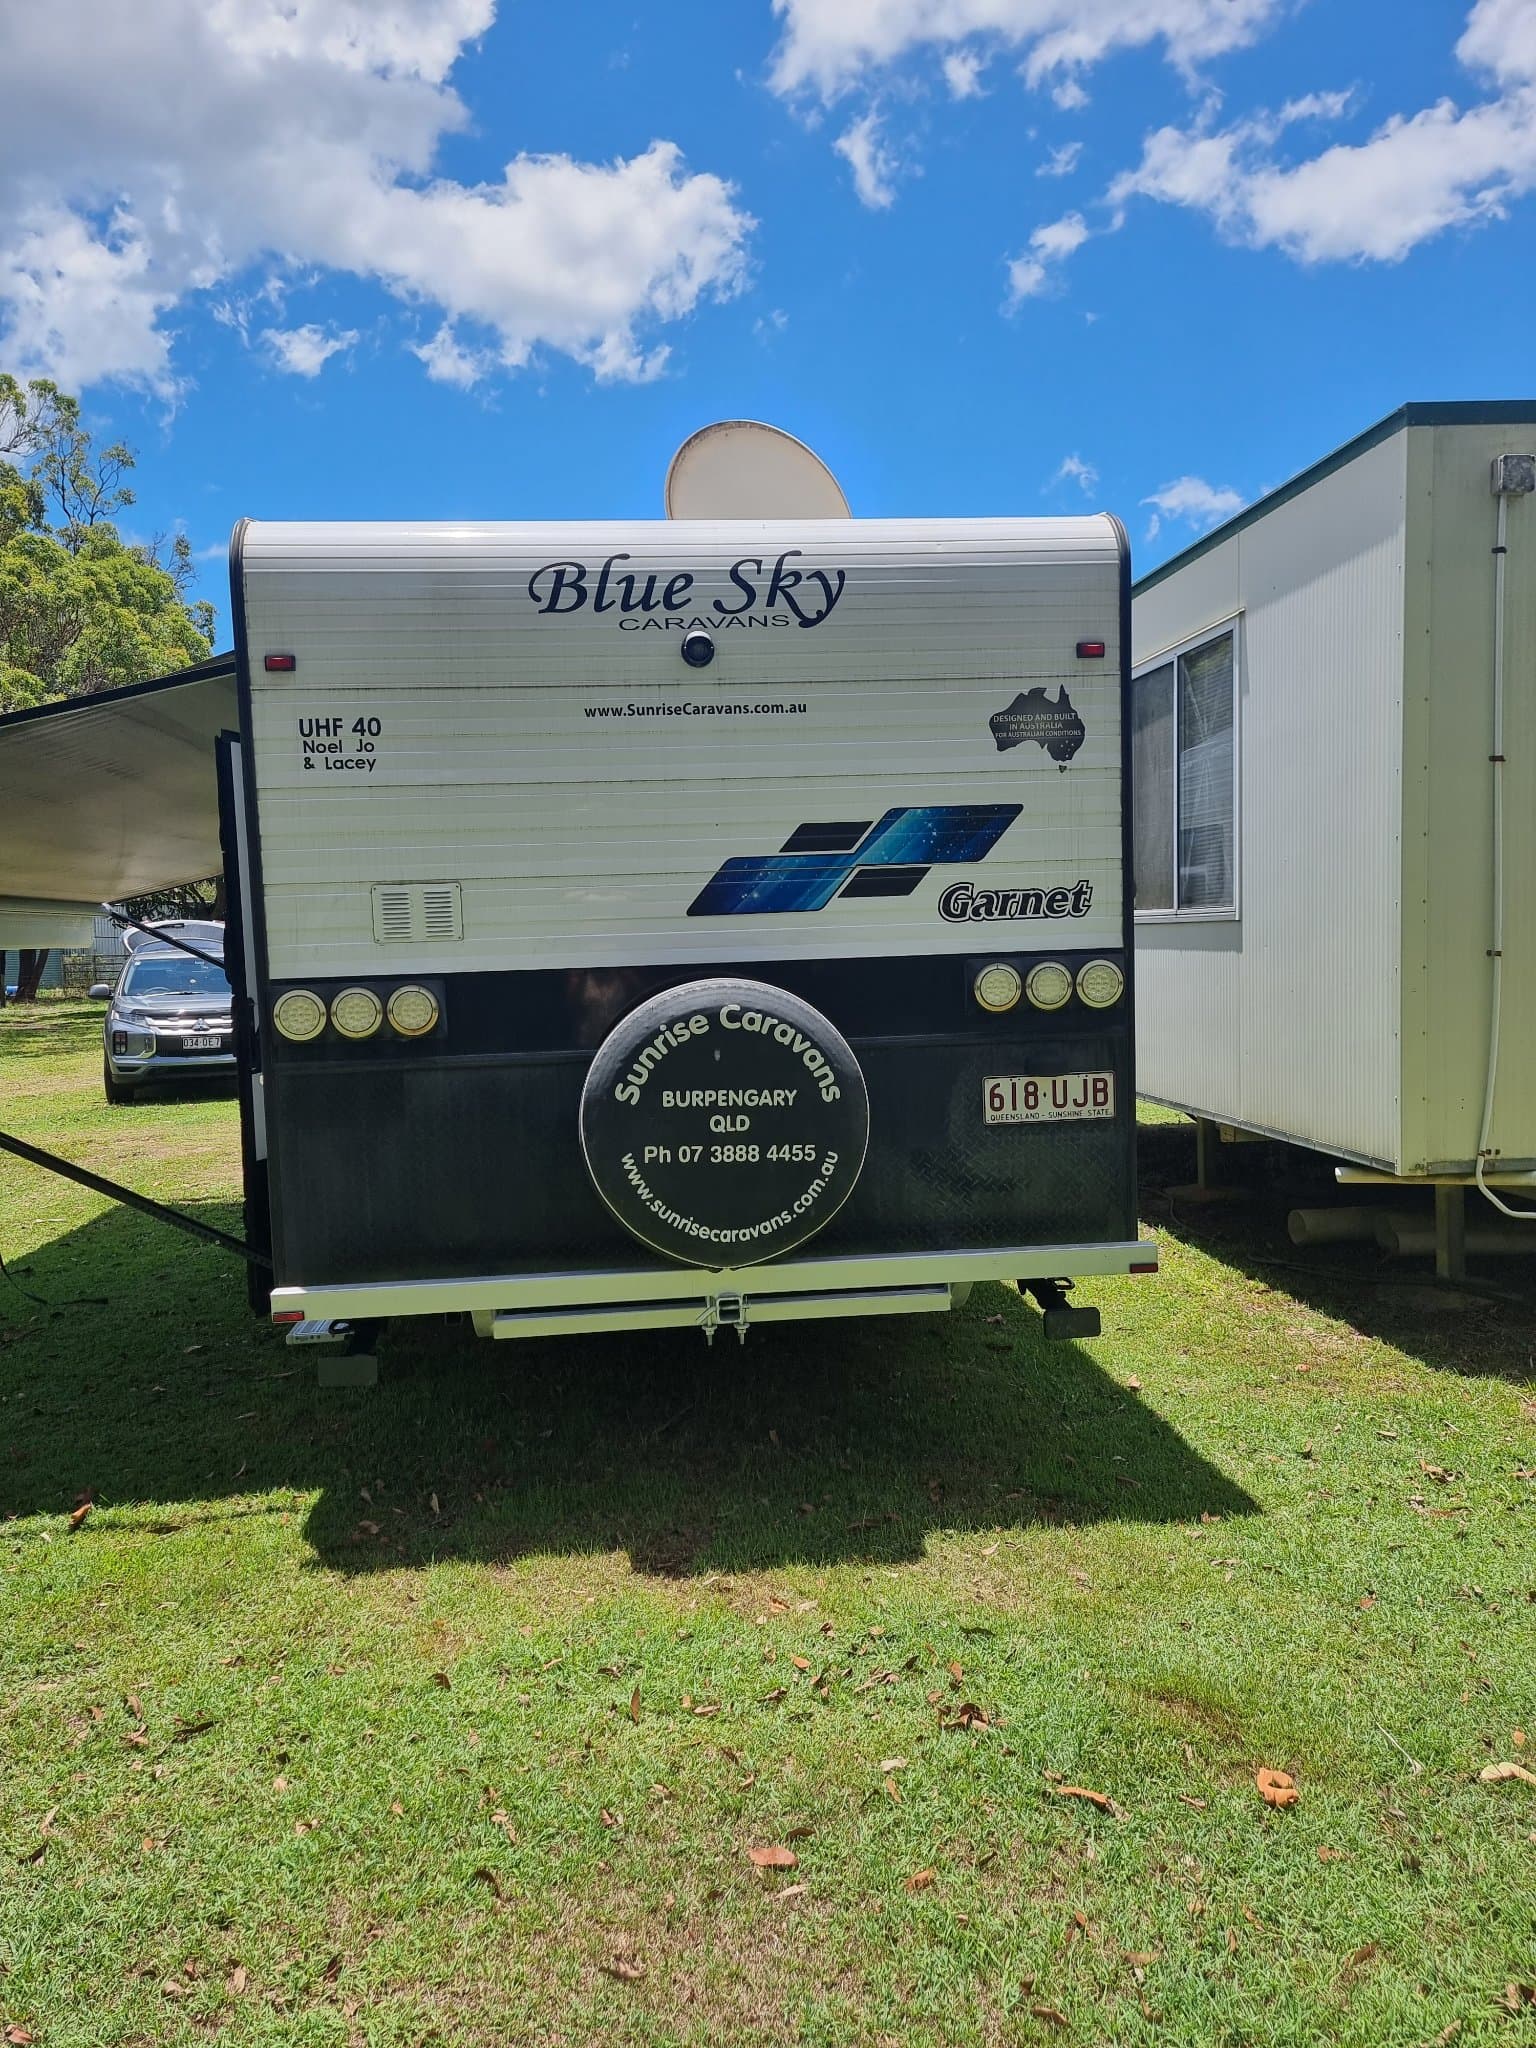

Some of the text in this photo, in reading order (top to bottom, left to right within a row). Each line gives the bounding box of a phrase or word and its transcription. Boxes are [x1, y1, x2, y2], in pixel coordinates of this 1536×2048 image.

[528, 550, 846, 629] Blue Sky
[618, 614, 790, 631] CARAVANS
[584, 703, 807, 718] www.SunriseCaravans.com.au
[993, 712, 1076, 723] DESIGNED AND BUILT
[298, 716, 382, 738] UHF 40
[1008, 730, 1044, 738] AUSTRALIAN
[1009, 721, 1064, 731] IN AUSTRALIA
[303, 738, 375, 754] Noel Jo
[303, 756, 377, 773] & Lacey
[938, 880, 1093, 923] Garnet
[614, 1004, 841, 1106] Sunrise Caravans
[662, 1089, 798, 1108] BURPENGARY
[990, 1113, 1040, 1121] QUEENSLAND
[1048, 1110, 1083, 1119] SUNSHINE
[1087, 1108, 1109, 1117] STATE
[709, 1115, 750, 1133] QLD
[644, 1144, 816, 1163] Ph 07 3888 4455
[620, 1150, 840, 1243] www.sunrisecaravans.com.au
